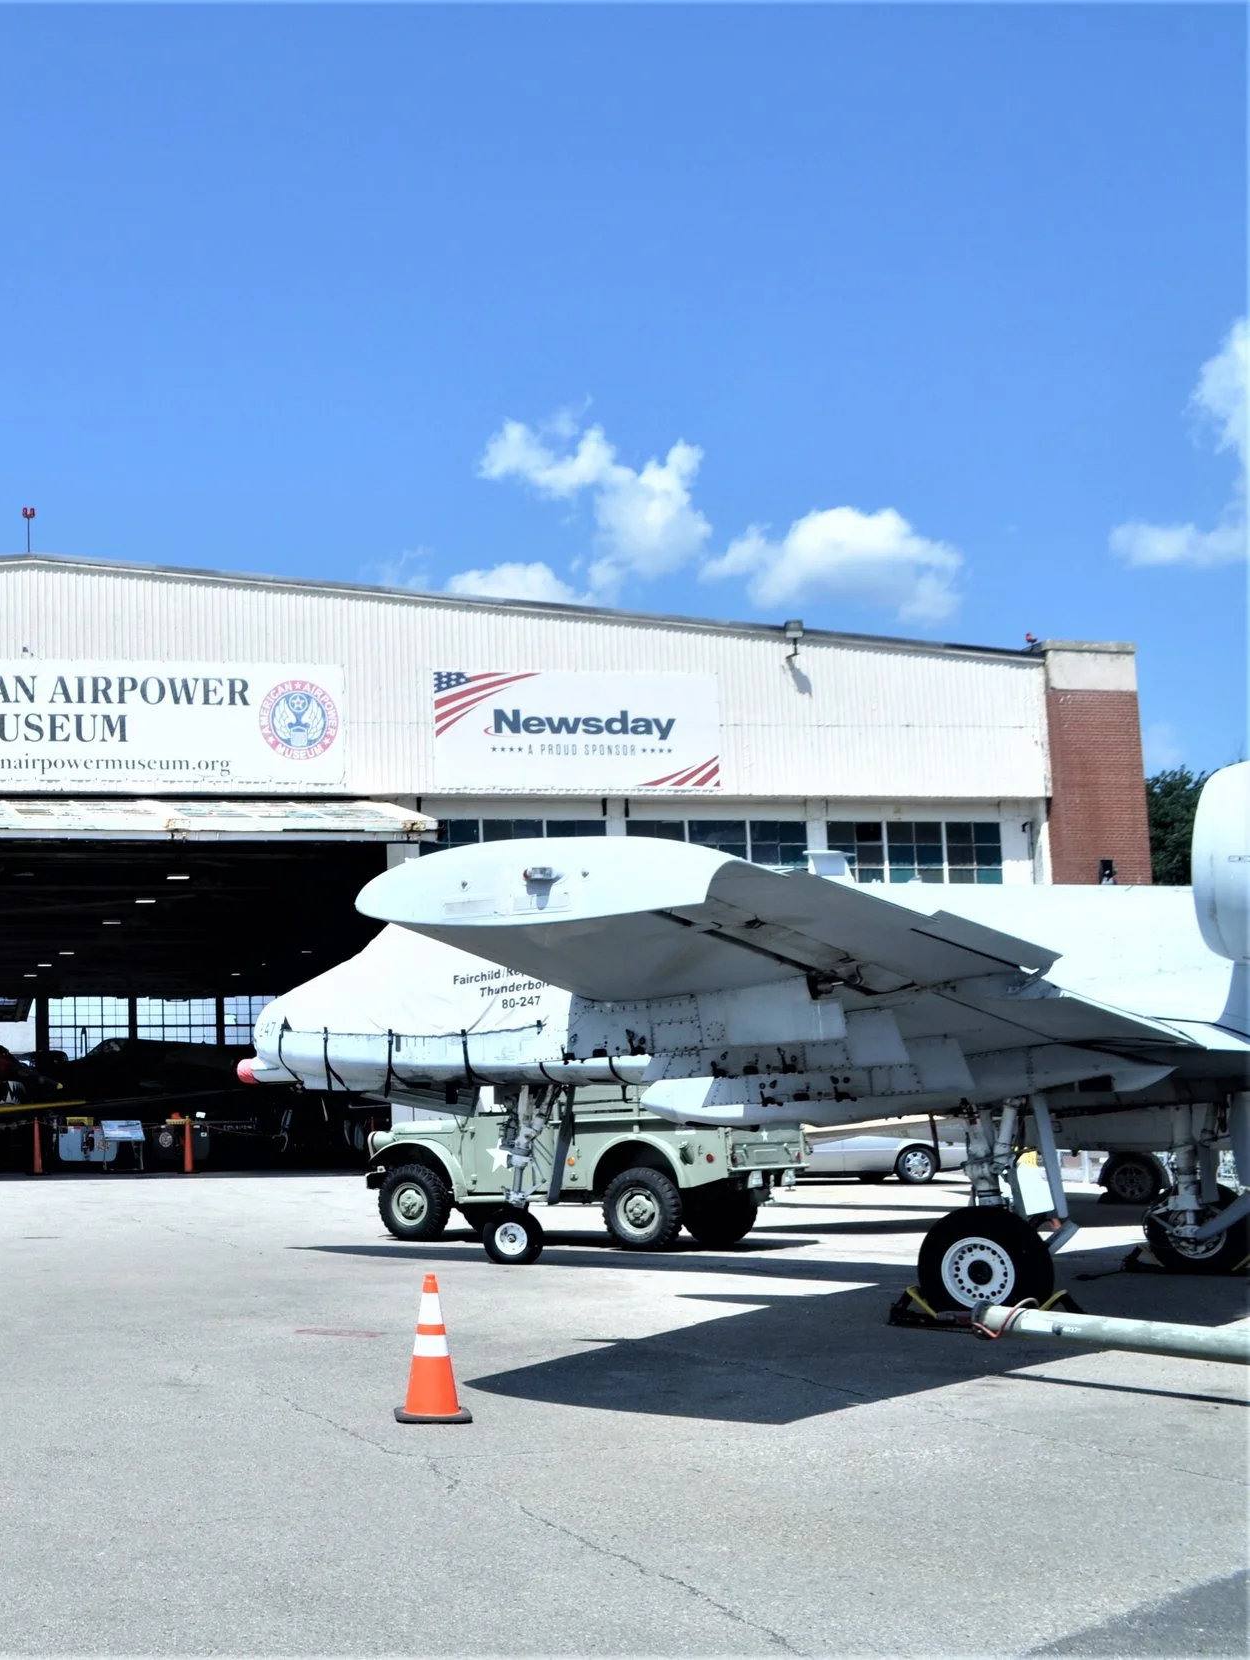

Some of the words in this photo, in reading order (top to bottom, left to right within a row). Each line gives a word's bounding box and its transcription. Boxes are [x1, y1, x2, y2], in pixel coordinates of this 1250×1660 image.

[48, 675, 251, 706] AIRPOWER
[493, 709, 676, 741] Newsday
[528, 744, 534, 755] A
[540, 744, 578, 755] PROUD
[584, 744, 637, 756] SPONSOR
[502, 996, 541, 1010] 80-247
